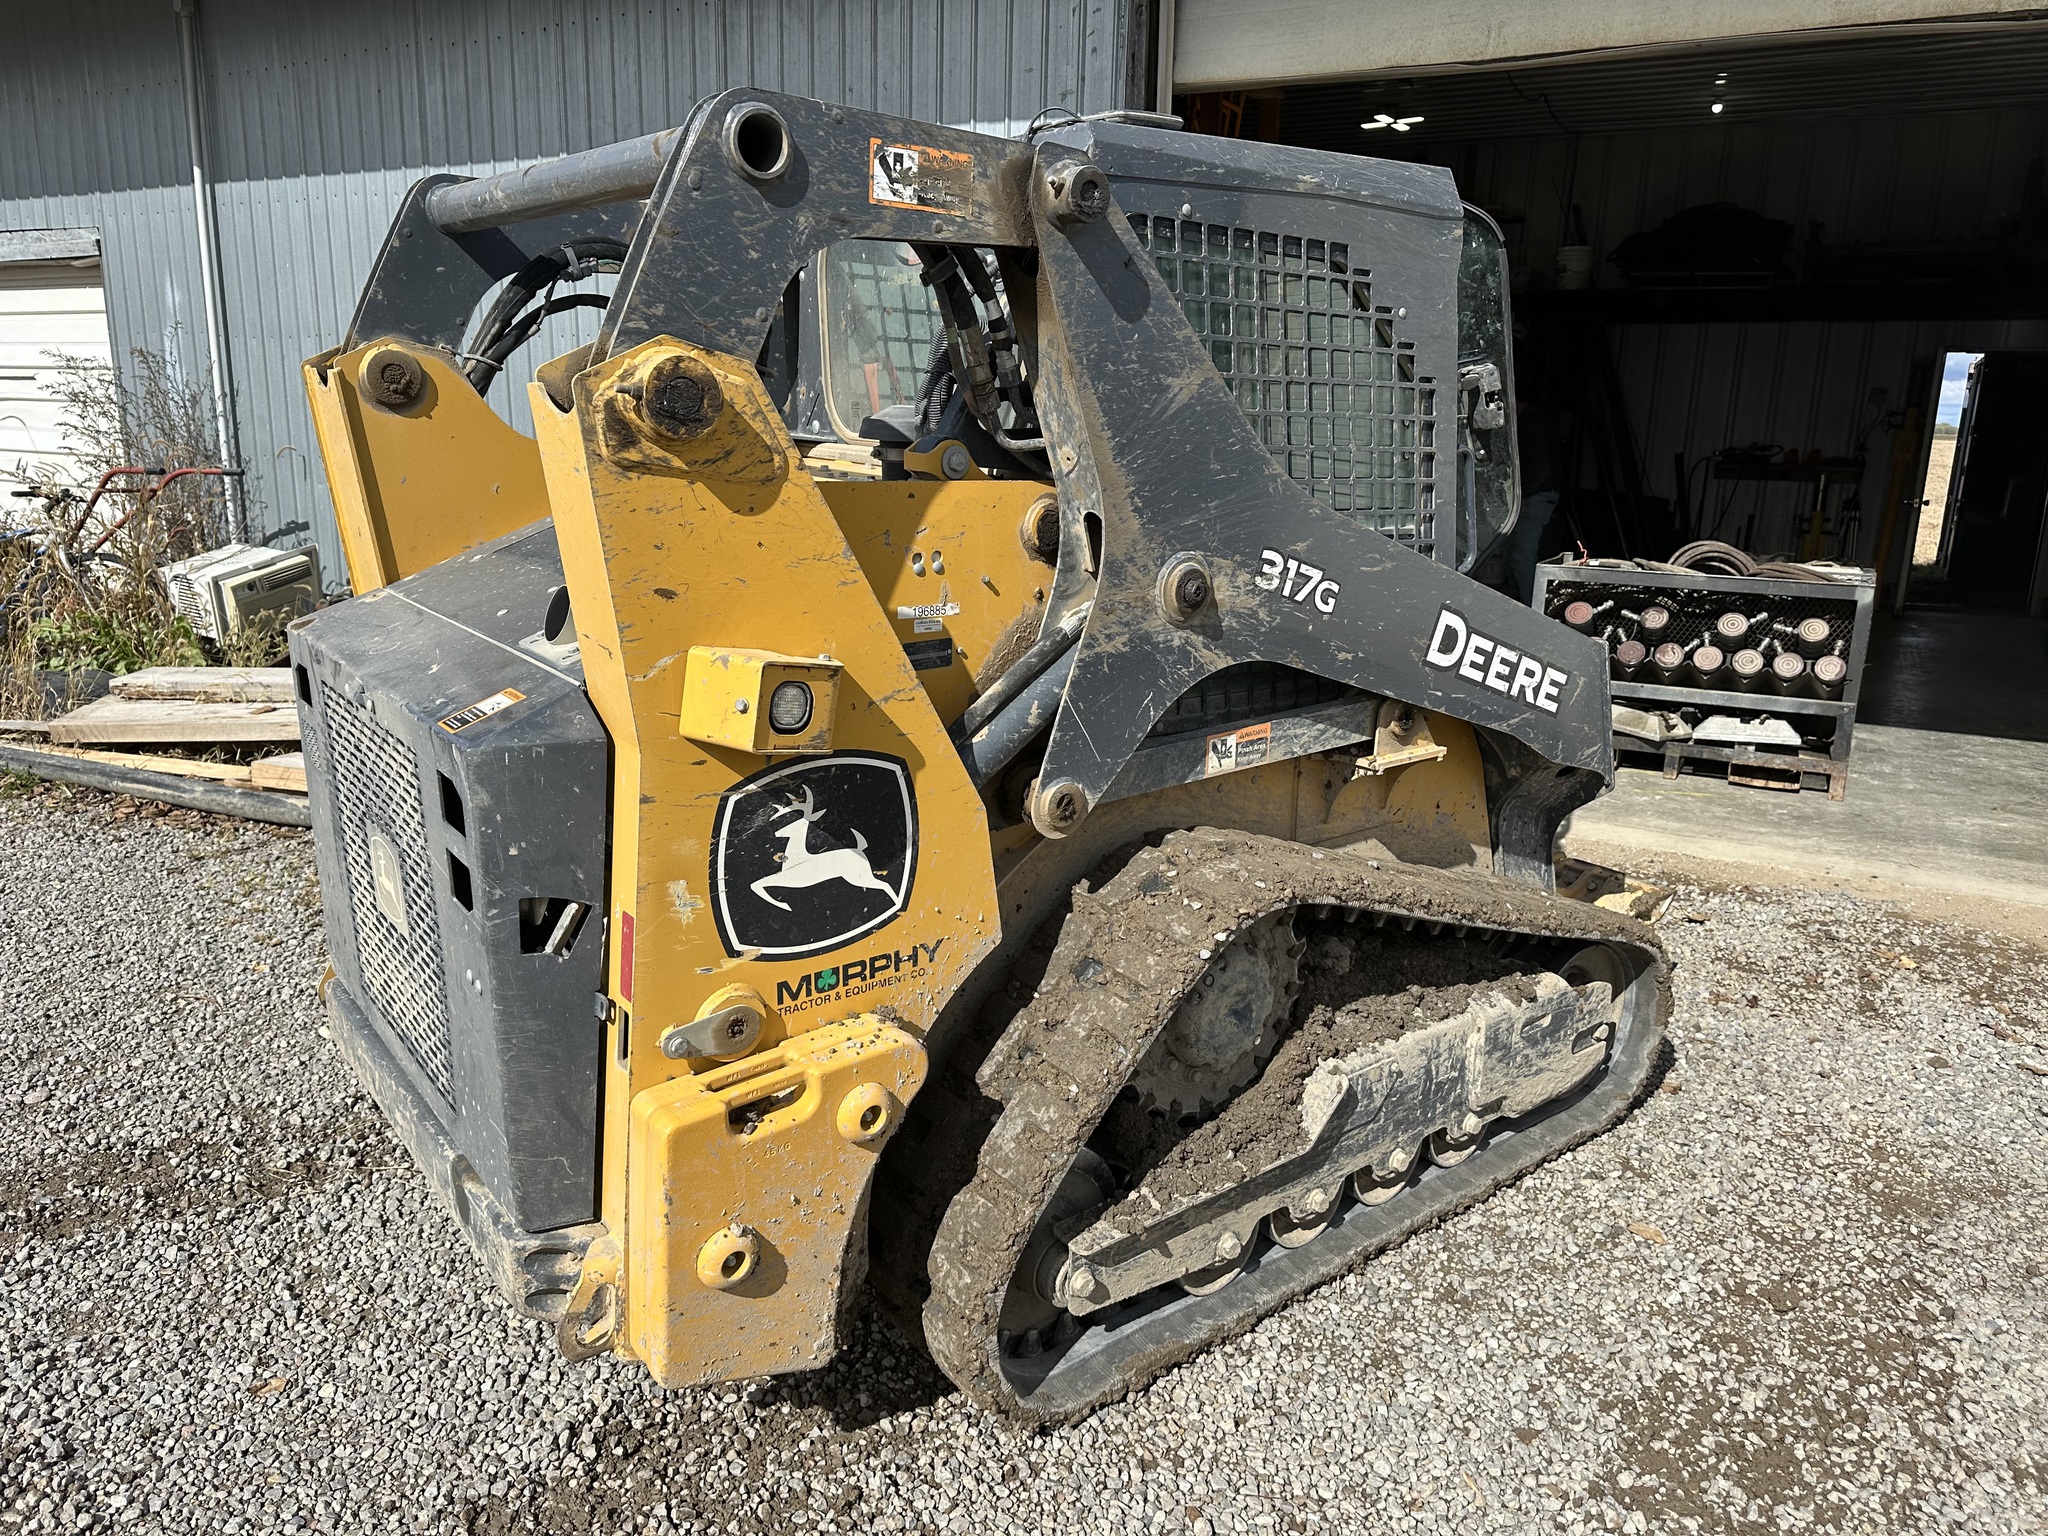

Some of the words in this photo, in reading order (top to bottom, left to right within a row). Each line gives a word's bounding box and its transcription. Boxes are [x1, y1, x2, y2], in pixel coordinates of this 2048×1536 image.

[913, 605, 947, 618] 196885
[1254, 549, 1341, 614] 317G
[1426, 608, 1568, 714] DEERE
[776, 937, 945, 1006] MURPHY
[777, 994, 831, 1018] TRACTOR
[834, 991, 842, 1001] &
[845, 973, 909, 998] EQUIPMENT
